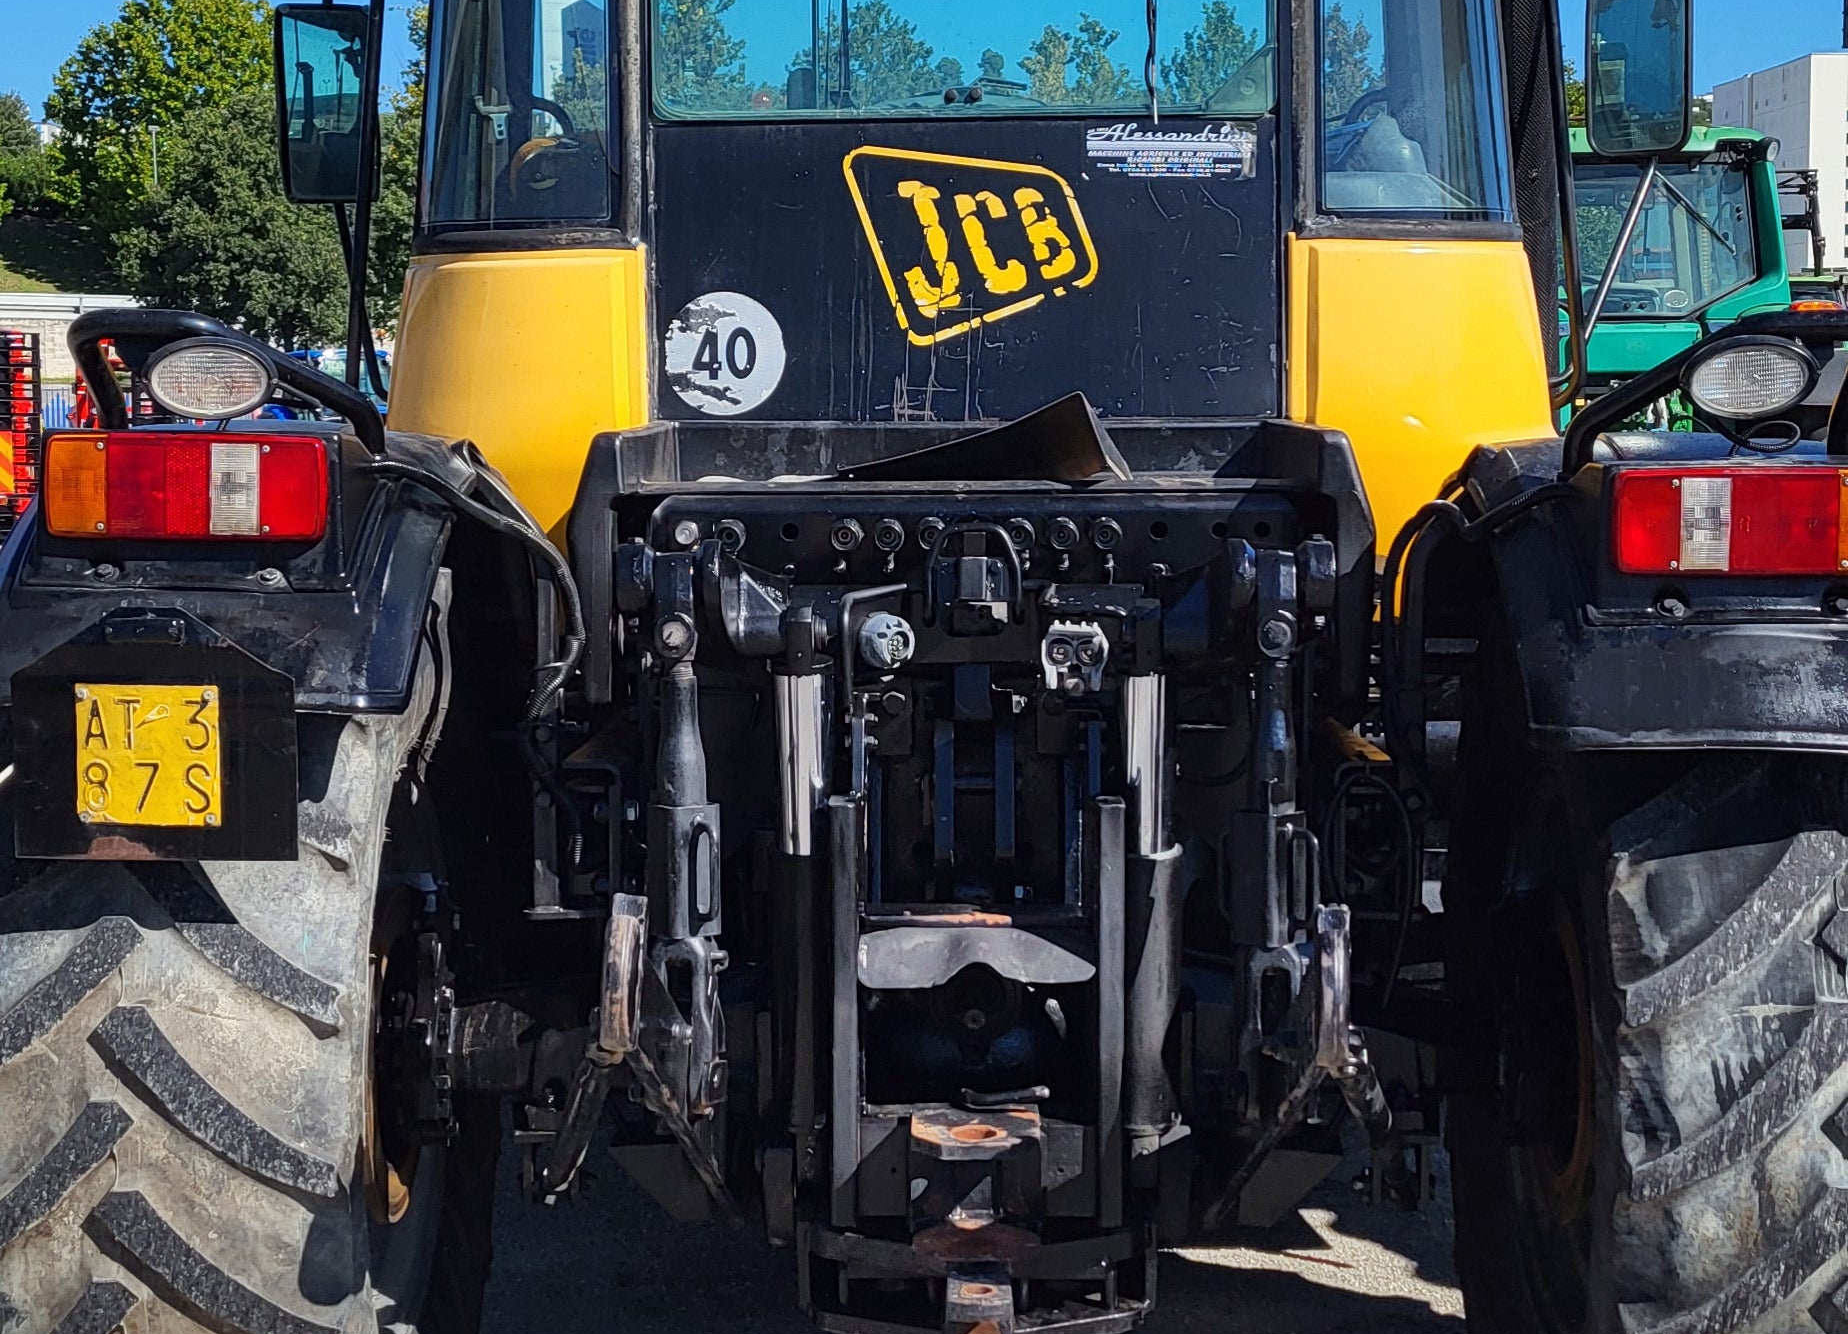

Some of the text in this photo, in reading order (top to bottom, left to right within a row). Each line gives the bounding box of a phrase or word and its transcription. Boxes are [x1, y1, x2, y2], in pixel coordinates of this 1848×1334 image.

[897, 180, 1077, 318] JCB
[692, 326, 756, 380] 40
[84, 697, 211, 753] AT 3
